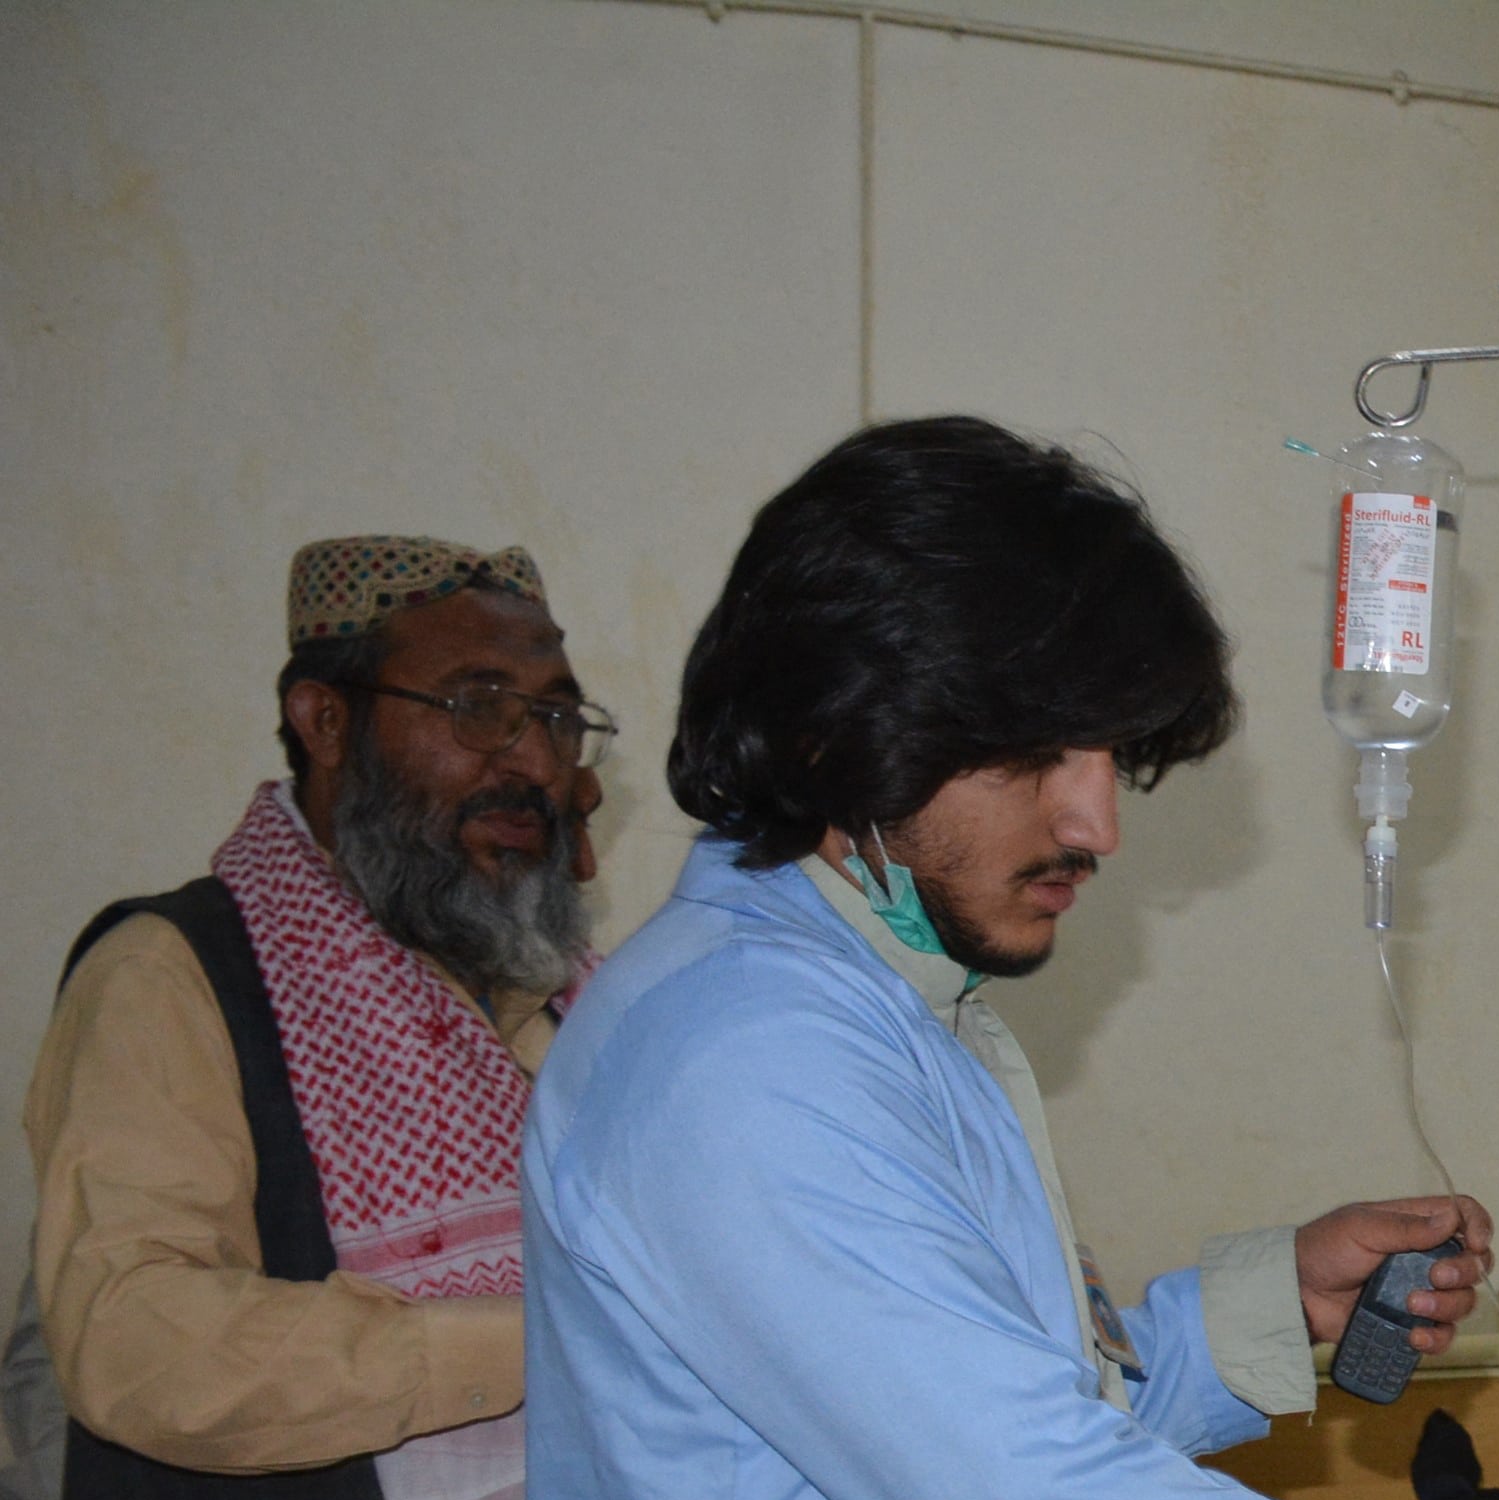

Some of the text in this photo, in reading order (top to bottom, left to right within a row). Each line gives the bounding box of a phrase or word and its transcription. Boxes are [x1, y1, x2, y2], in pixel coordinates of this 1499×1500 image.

[1354, 508, 1432, 526] Sterifluid-RL
[1336, 513, 1352, 647] 121°C Sterilized
[1402, 631, 1424, 649] RL
